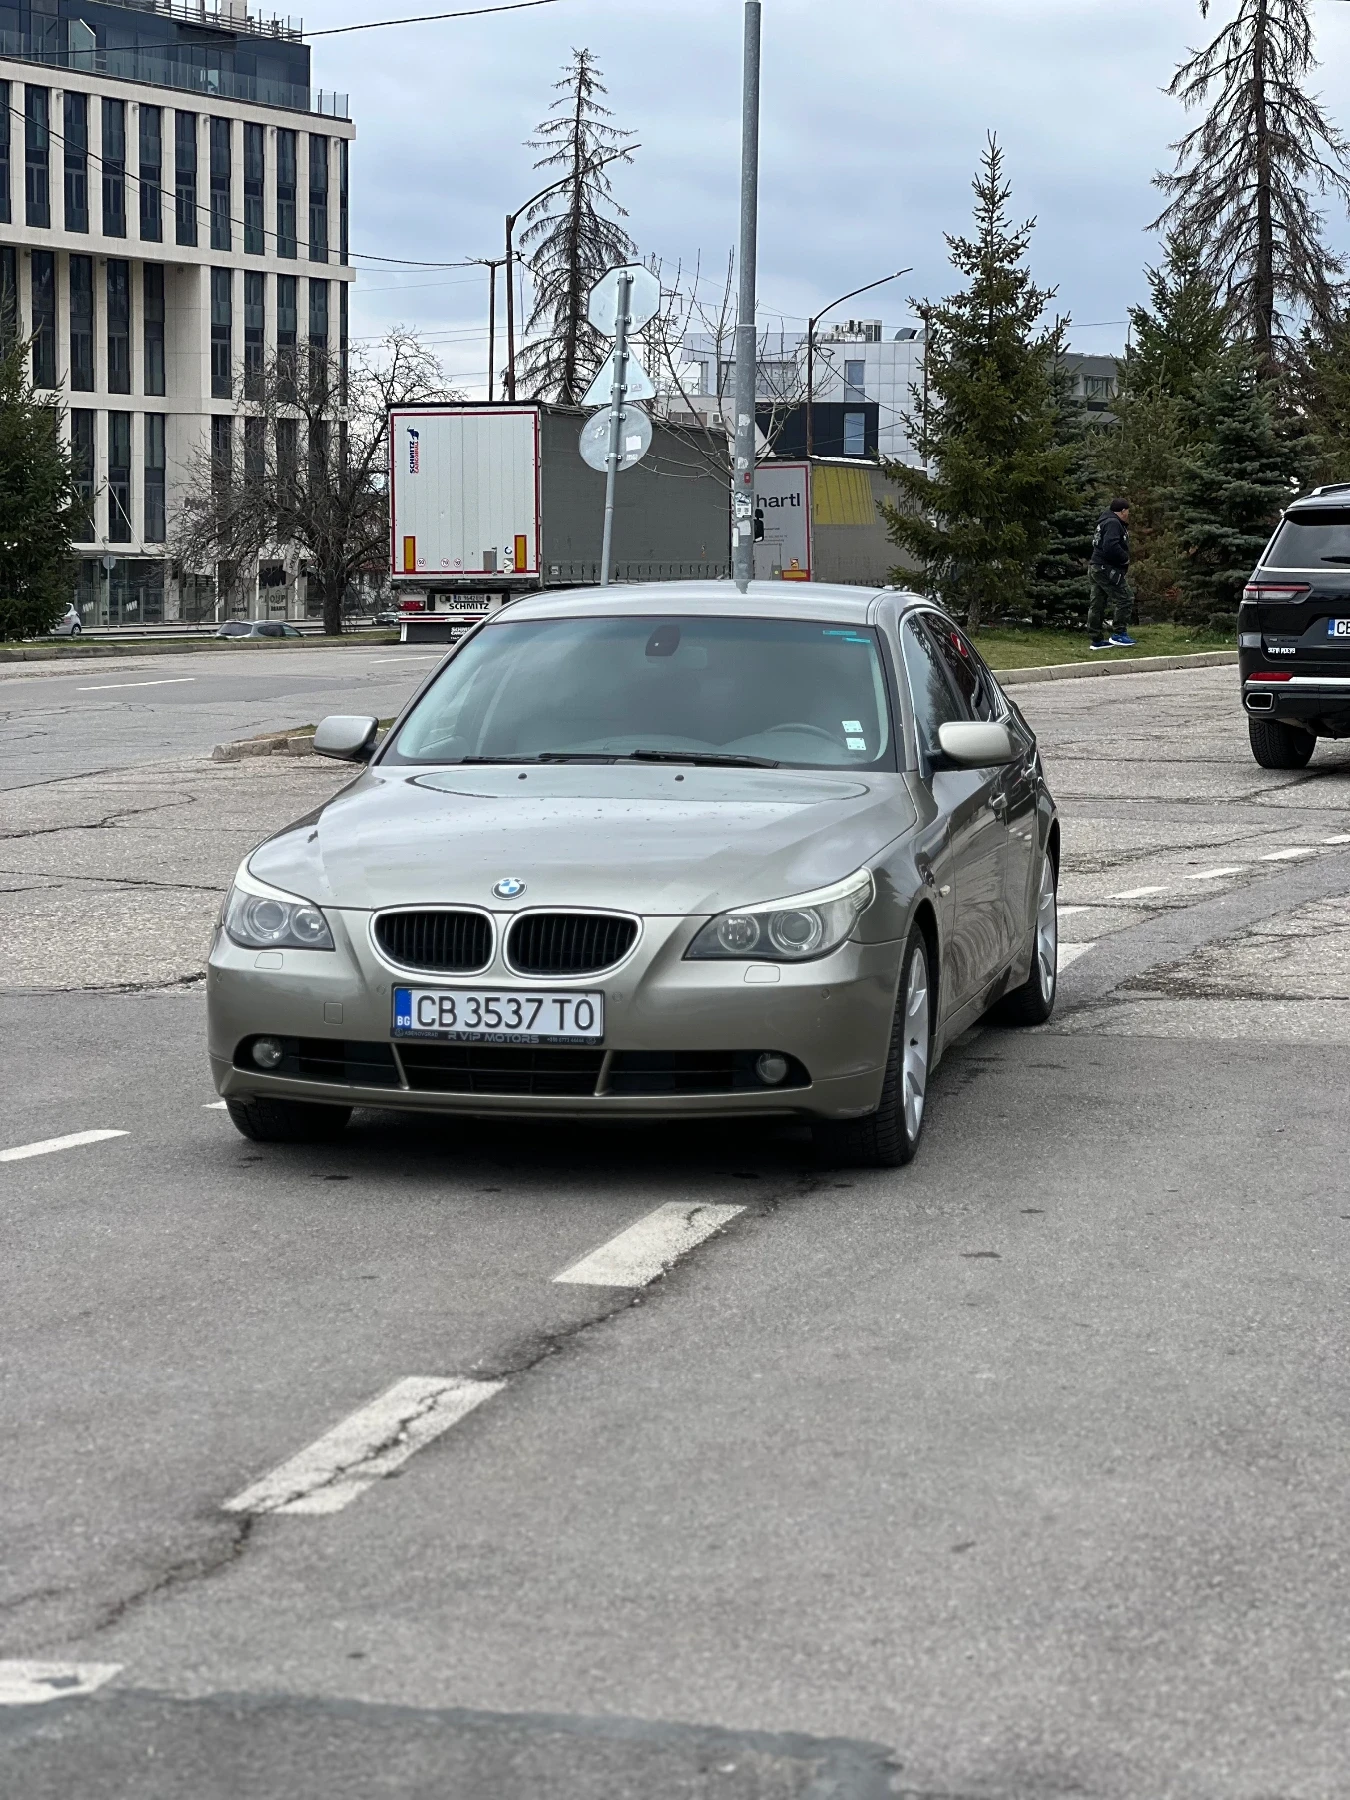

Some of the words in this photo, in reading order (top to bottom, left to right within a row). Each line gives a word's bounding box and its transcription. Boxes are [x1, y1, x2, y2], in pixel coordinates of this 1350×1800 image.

[756, 492, 801, 508] hartl
[449, 602, 489, 610] SCHMITZ
[416, 994, 458, 1028] CB
[463, 996, 544, 1030] 3537
[551, 998, 595, 1031] TO
[396, 1015, 411, 1026] BG
[483, 1033, 540, 1044] MOTORS
